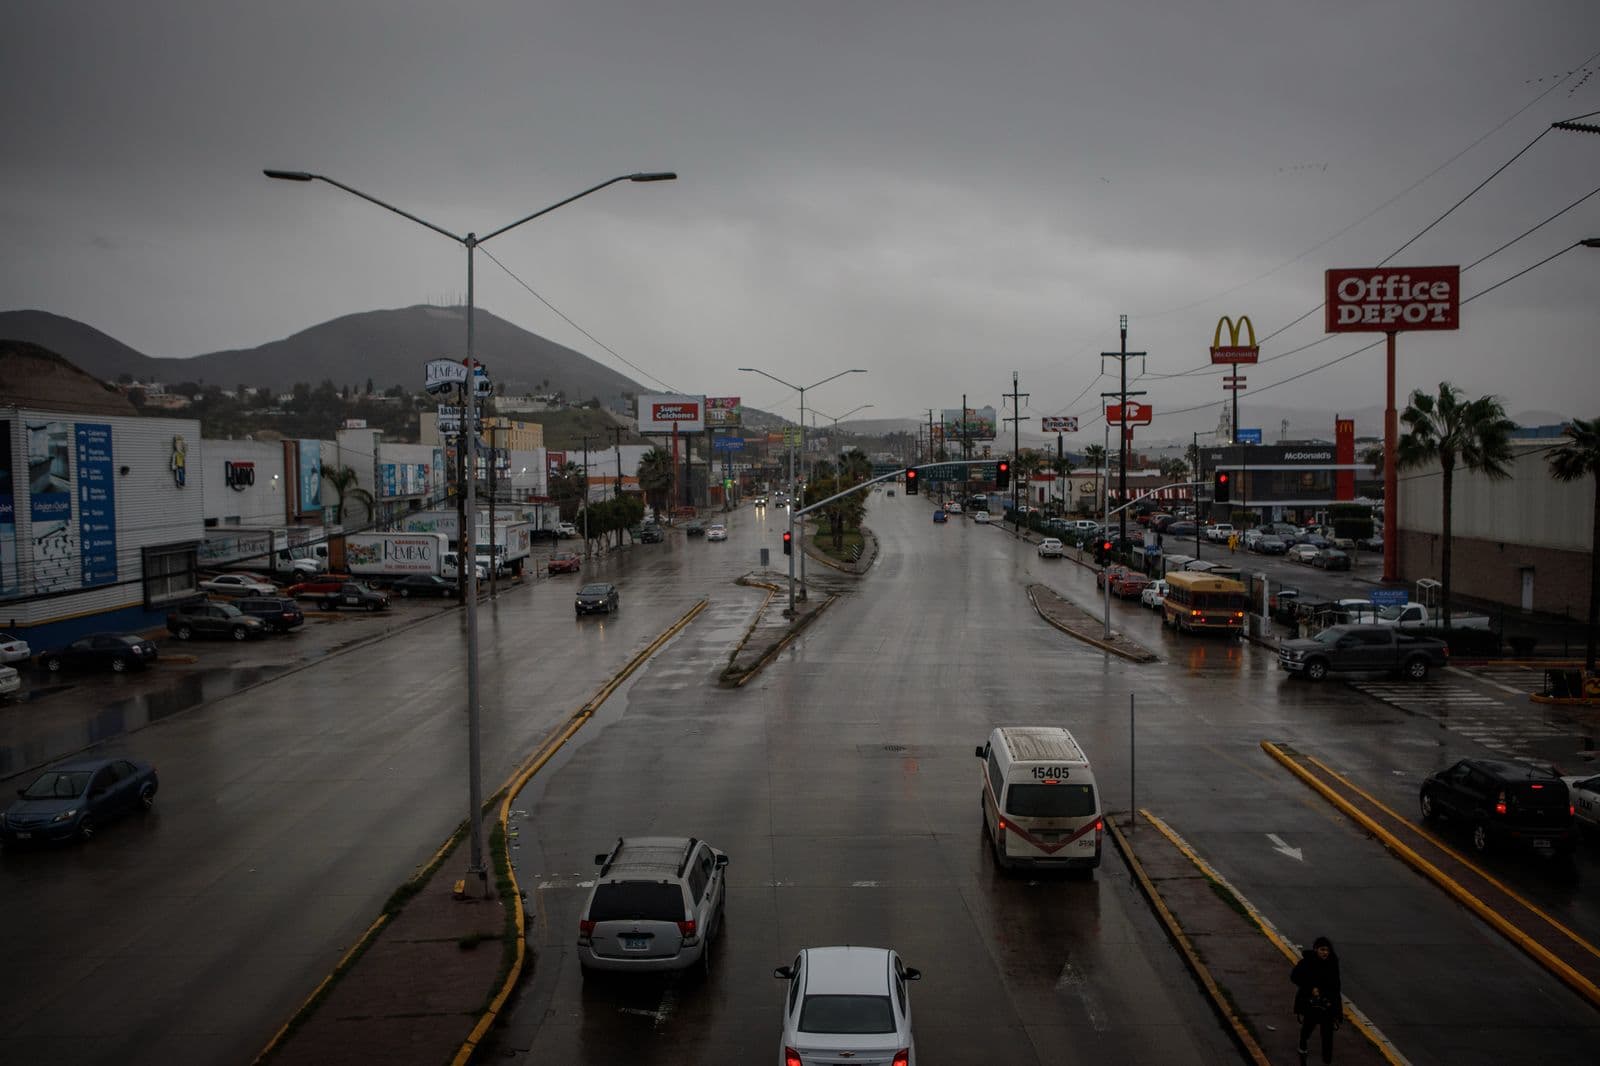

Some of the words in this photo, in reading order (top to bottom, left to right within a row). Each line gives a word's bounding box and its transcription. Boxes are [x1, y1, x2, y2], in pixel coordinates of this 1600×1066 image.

[1338, 275, 1450, 302] Office
[1337, 302, 1450, 325] DEPOT
[656, 412, 695, 420] Colchones
[660, 406, 682, 414] Super
[1284, 452, 1331, 461] McDonald's
[384, 539, 432, 563] REMBAO
[1032, 767, 1070, 779] 15405
